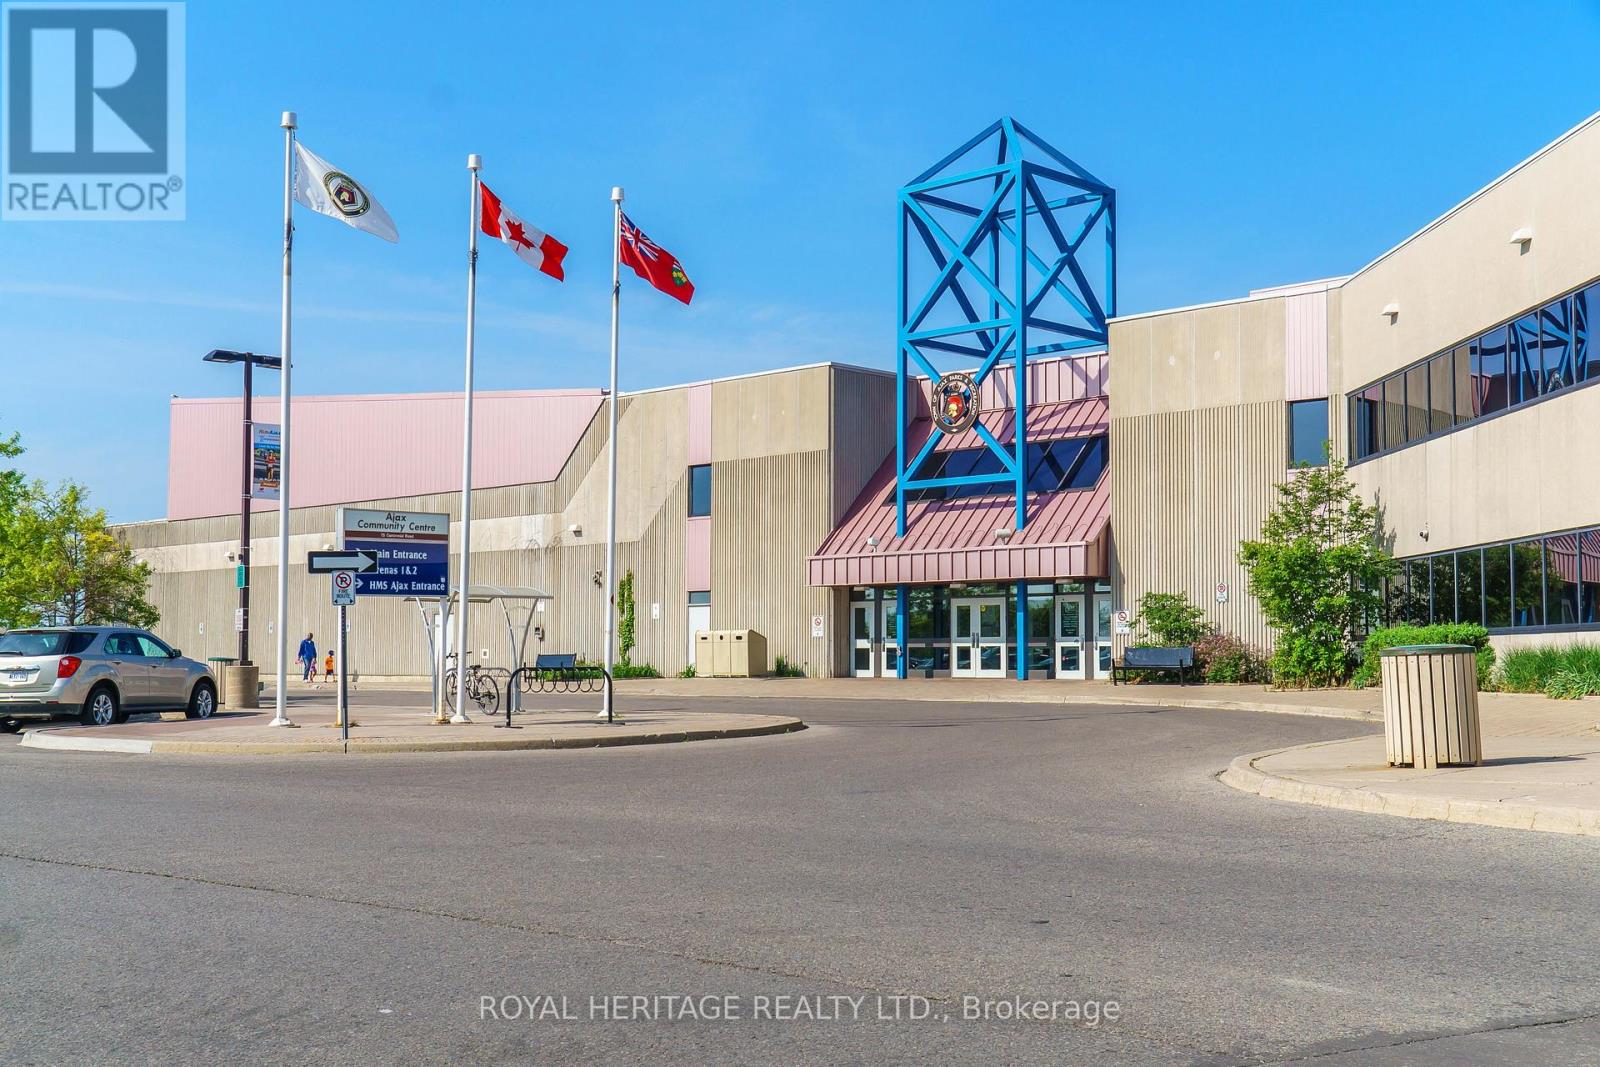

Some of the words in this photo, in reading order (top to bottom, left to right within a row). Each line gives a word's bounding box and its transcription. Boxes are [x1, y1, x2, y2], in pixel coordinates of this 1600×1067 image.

[386, 513, 406, 523] Ajax
[358, 520, 405, 531] Community
[409, 522, 436, 531] Centre
[375, 549, 390, 559] ain
[393, 550, 428, 560] Entrance
[369, 581, 388, 590] HMS
[390, 581, 409, 592] Ajax
[411, 582, 446, 591] Entrance
